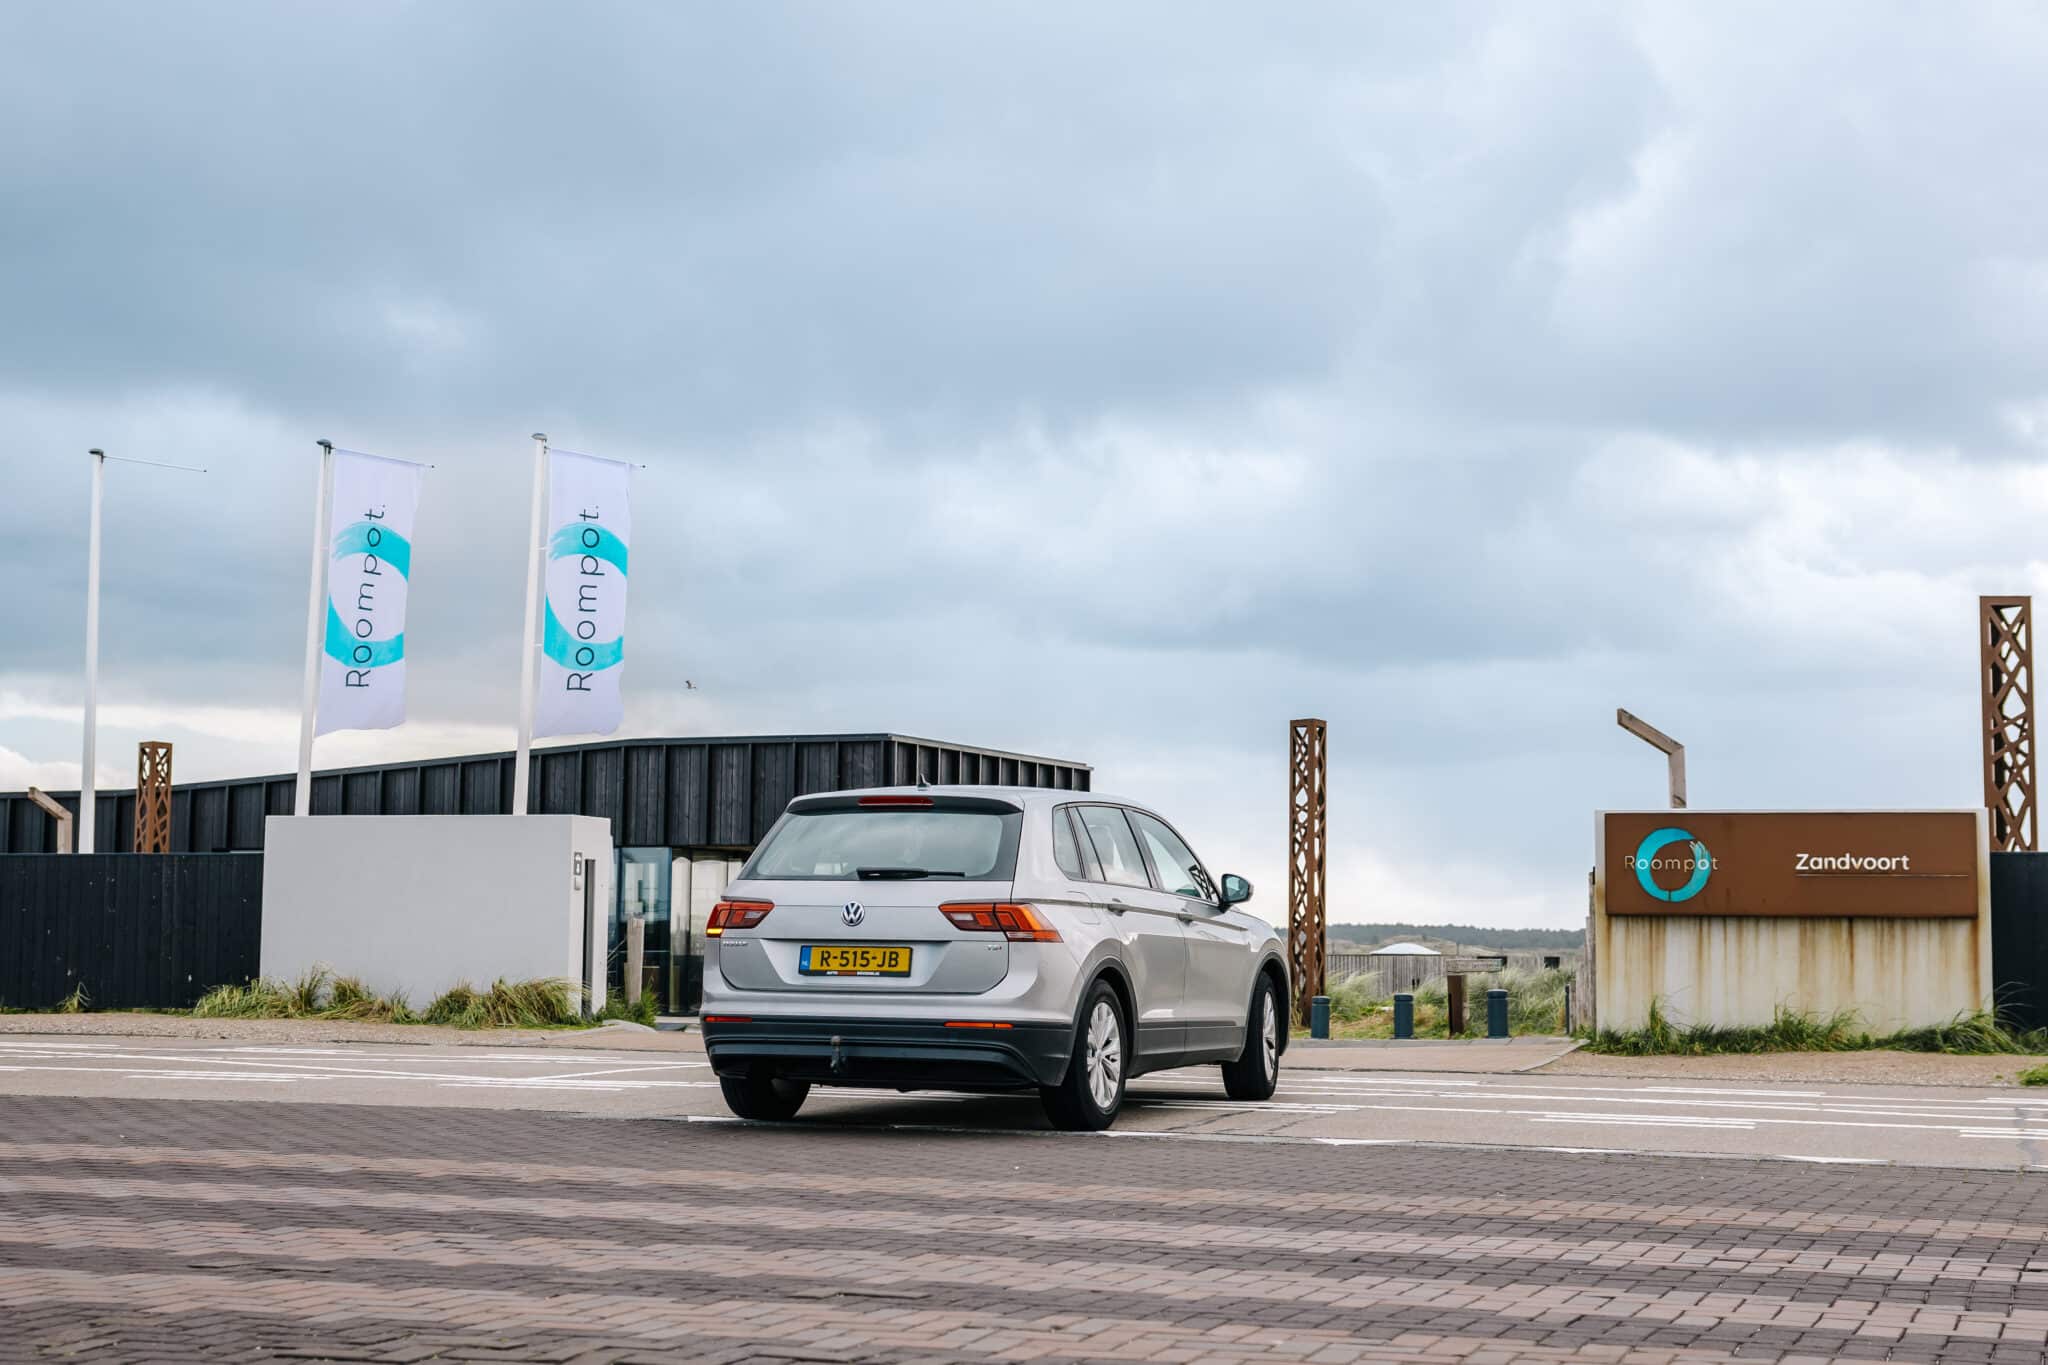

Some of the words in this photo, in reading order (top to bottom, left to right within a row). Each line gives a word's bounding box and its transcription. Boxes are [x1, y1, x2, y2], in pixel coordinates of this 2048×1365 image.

[1624, 855, 1719, 873] Roompot
[1795, 853, 1910, 871] Zandvoort
[820, 950, 900, 968] R-515-JB
